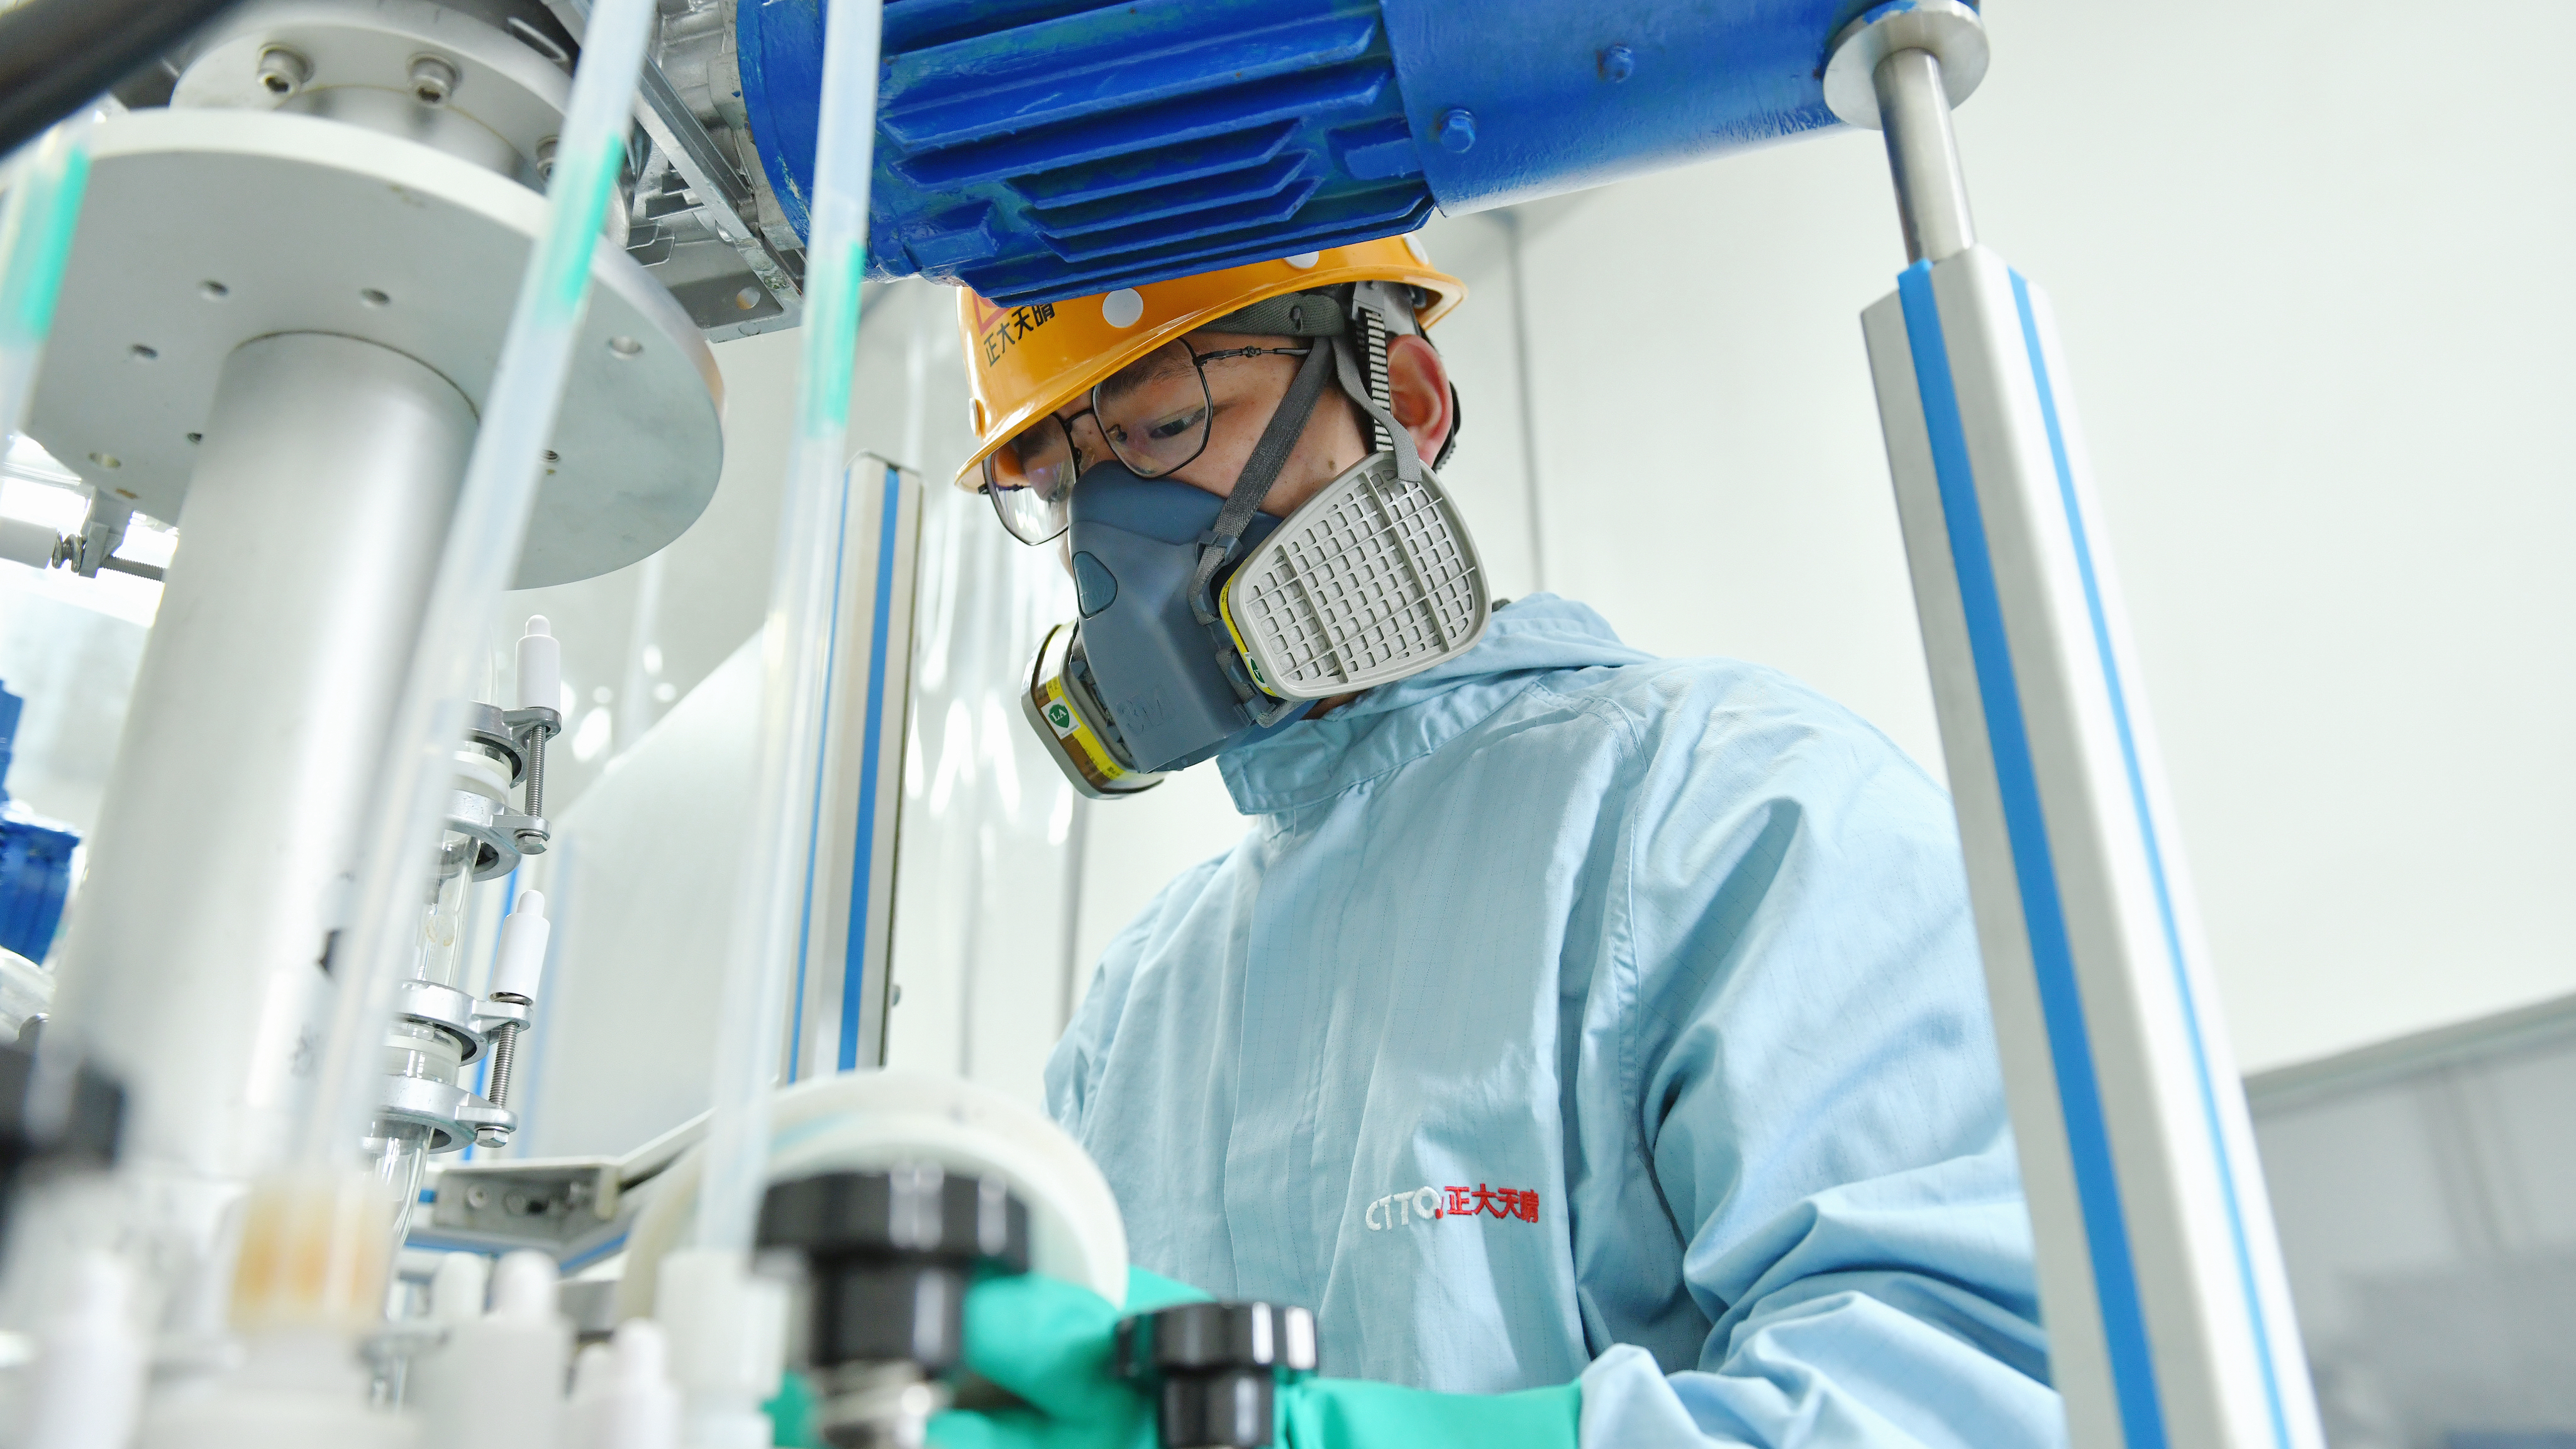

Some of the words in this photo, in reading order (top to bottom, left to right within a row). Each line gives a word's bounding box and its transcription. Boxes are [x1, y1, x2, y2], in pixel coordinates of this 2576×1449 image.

[1050, 708, 1067, 721] LA
[1444, 1183, 1539, 1223] 正大天晴
